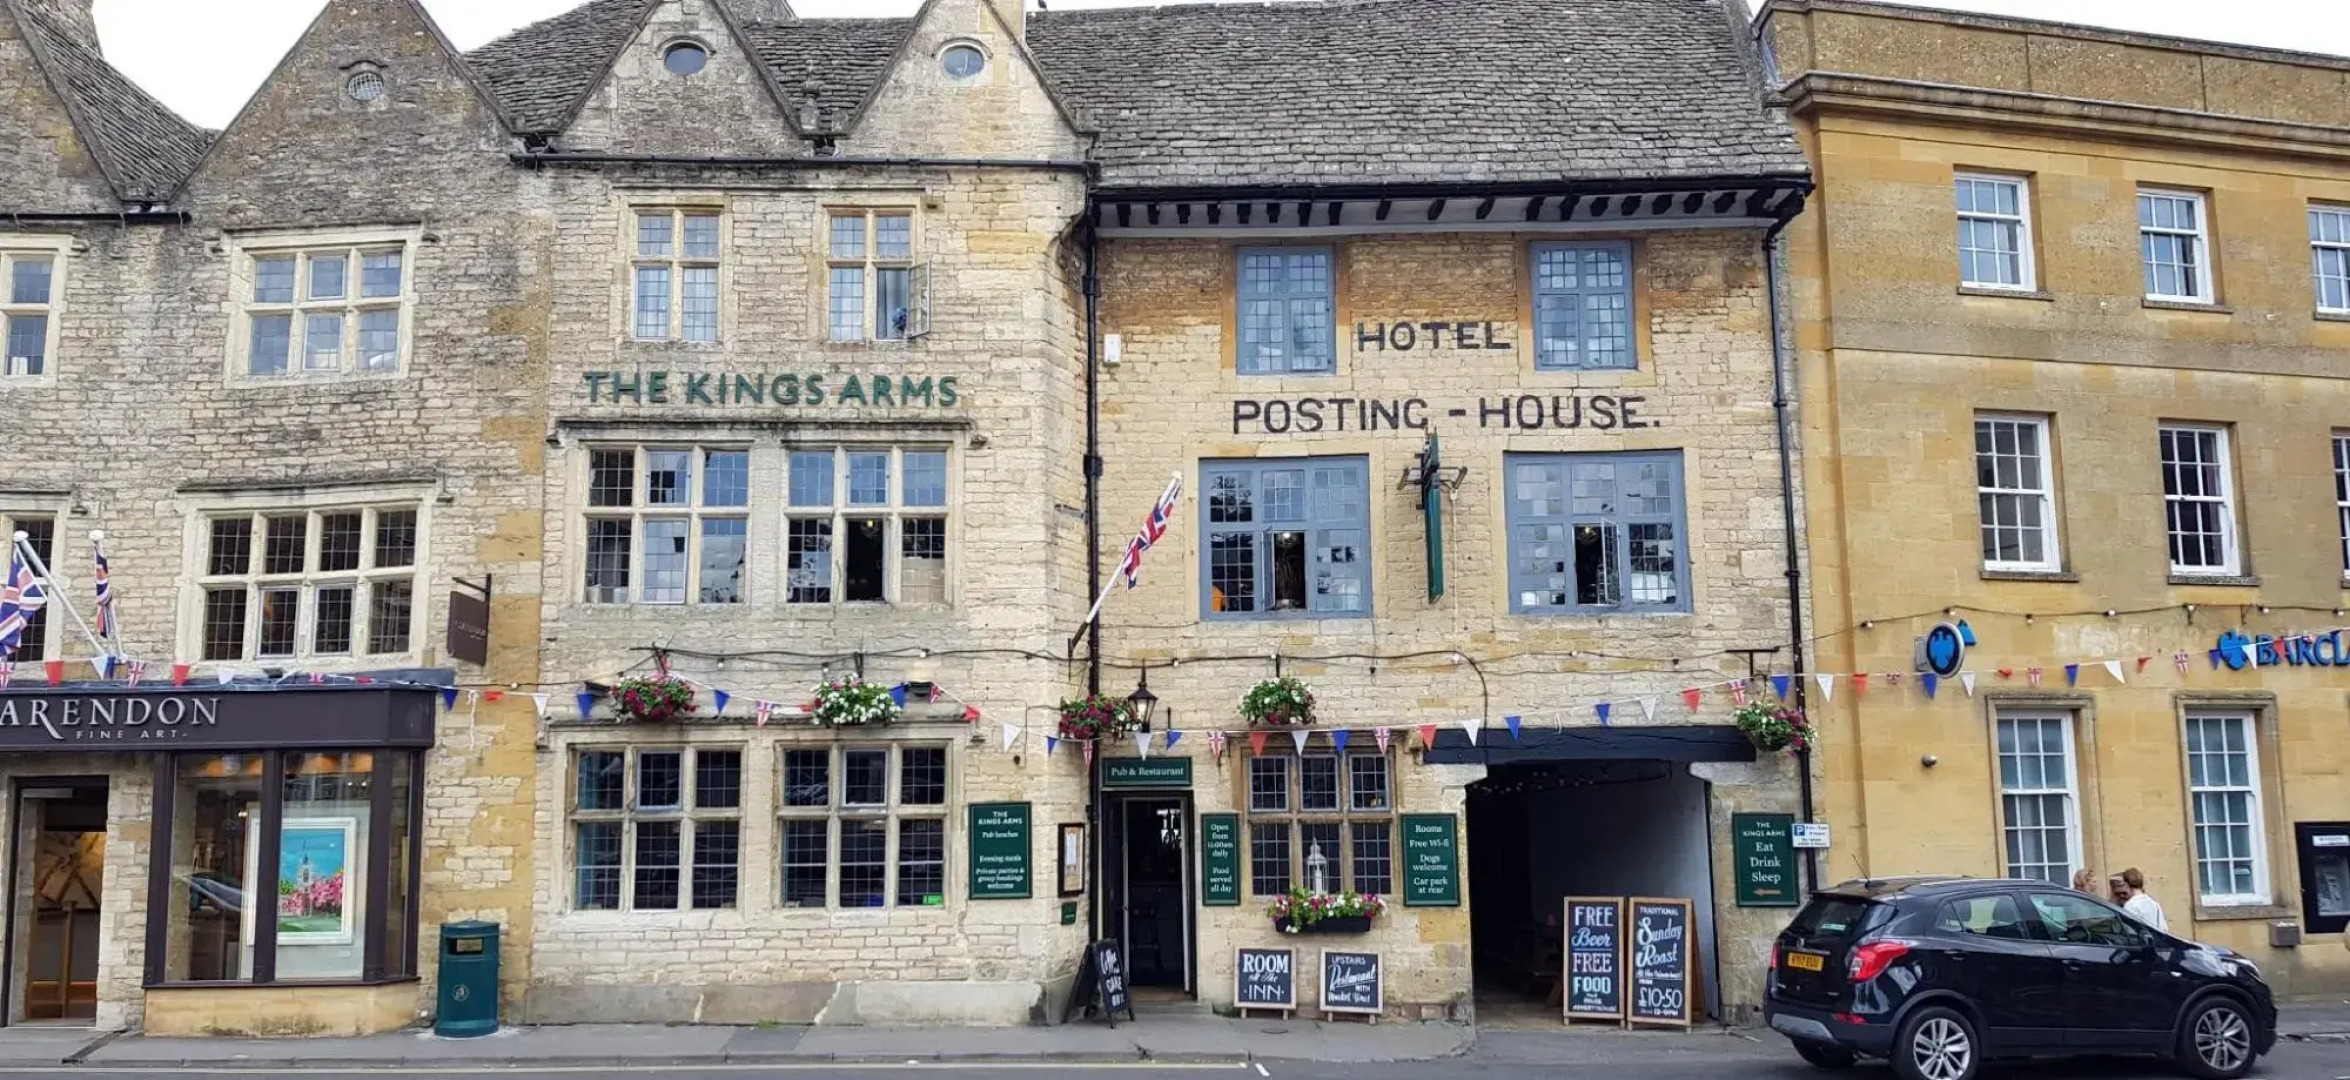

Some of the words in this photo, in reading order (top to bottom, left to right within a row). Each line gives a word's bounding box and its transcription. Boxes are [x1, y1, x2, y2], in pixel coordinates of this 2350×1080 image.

[1357, 321, 1511, 351] HOTEL
[583, 371, 669, 404] THE
[686, 372, 823, 405] KINGS
[837, 374, 959, 407] ARMS
[76, 730, 125, 740] FINE
[1111, 766, 1128, 776] Pub
[1129, 767, 1137, 776] &
[1138, 766, 1184, 776] Restaurant
[1210, 823, 1229, 833] Open
[1415, 824, 1443, 833] Rooms
[1212, 832, 1228, 840] from
[1409, 839, 1428, 848] Free
[1755, 841, 1774, 852] Eat
[1212, 849, 1229, 858] daily
[980, 855, 1004, 864] Evening
[1420, 854, 1441, 864] Dogs
[1750, 856, 1781, 867] Drink
[1212, 866, 1229, 874] Food
[1210, 875, 1232, 883] served
[1413, 877, 1429, 886] Car
[1430, 876, 1448, 887] park
[1752, 872, 1781, 884] Sleep
[1210, 884, 1220, 893] all
[1220, 884, 1232, 894] day
[1639, 906, 1679, 916] TRADITIONAL
[1574, 906, 1614, 927] FREE
[1636, 916, 1683, 946] Sunday
[1571, 926, 1613, 947] Beer
[1331, 955, 1366, 965] UPSTAIRS
[1635, 943, 1678, 968] Roast
[1242, 953, 1289, 973] ROOM
[1572, 952, 1613, 973] FREE
[1327, 963, 1377, 991] Restaurant
[1572, 976, 1612, 995] FOOD
